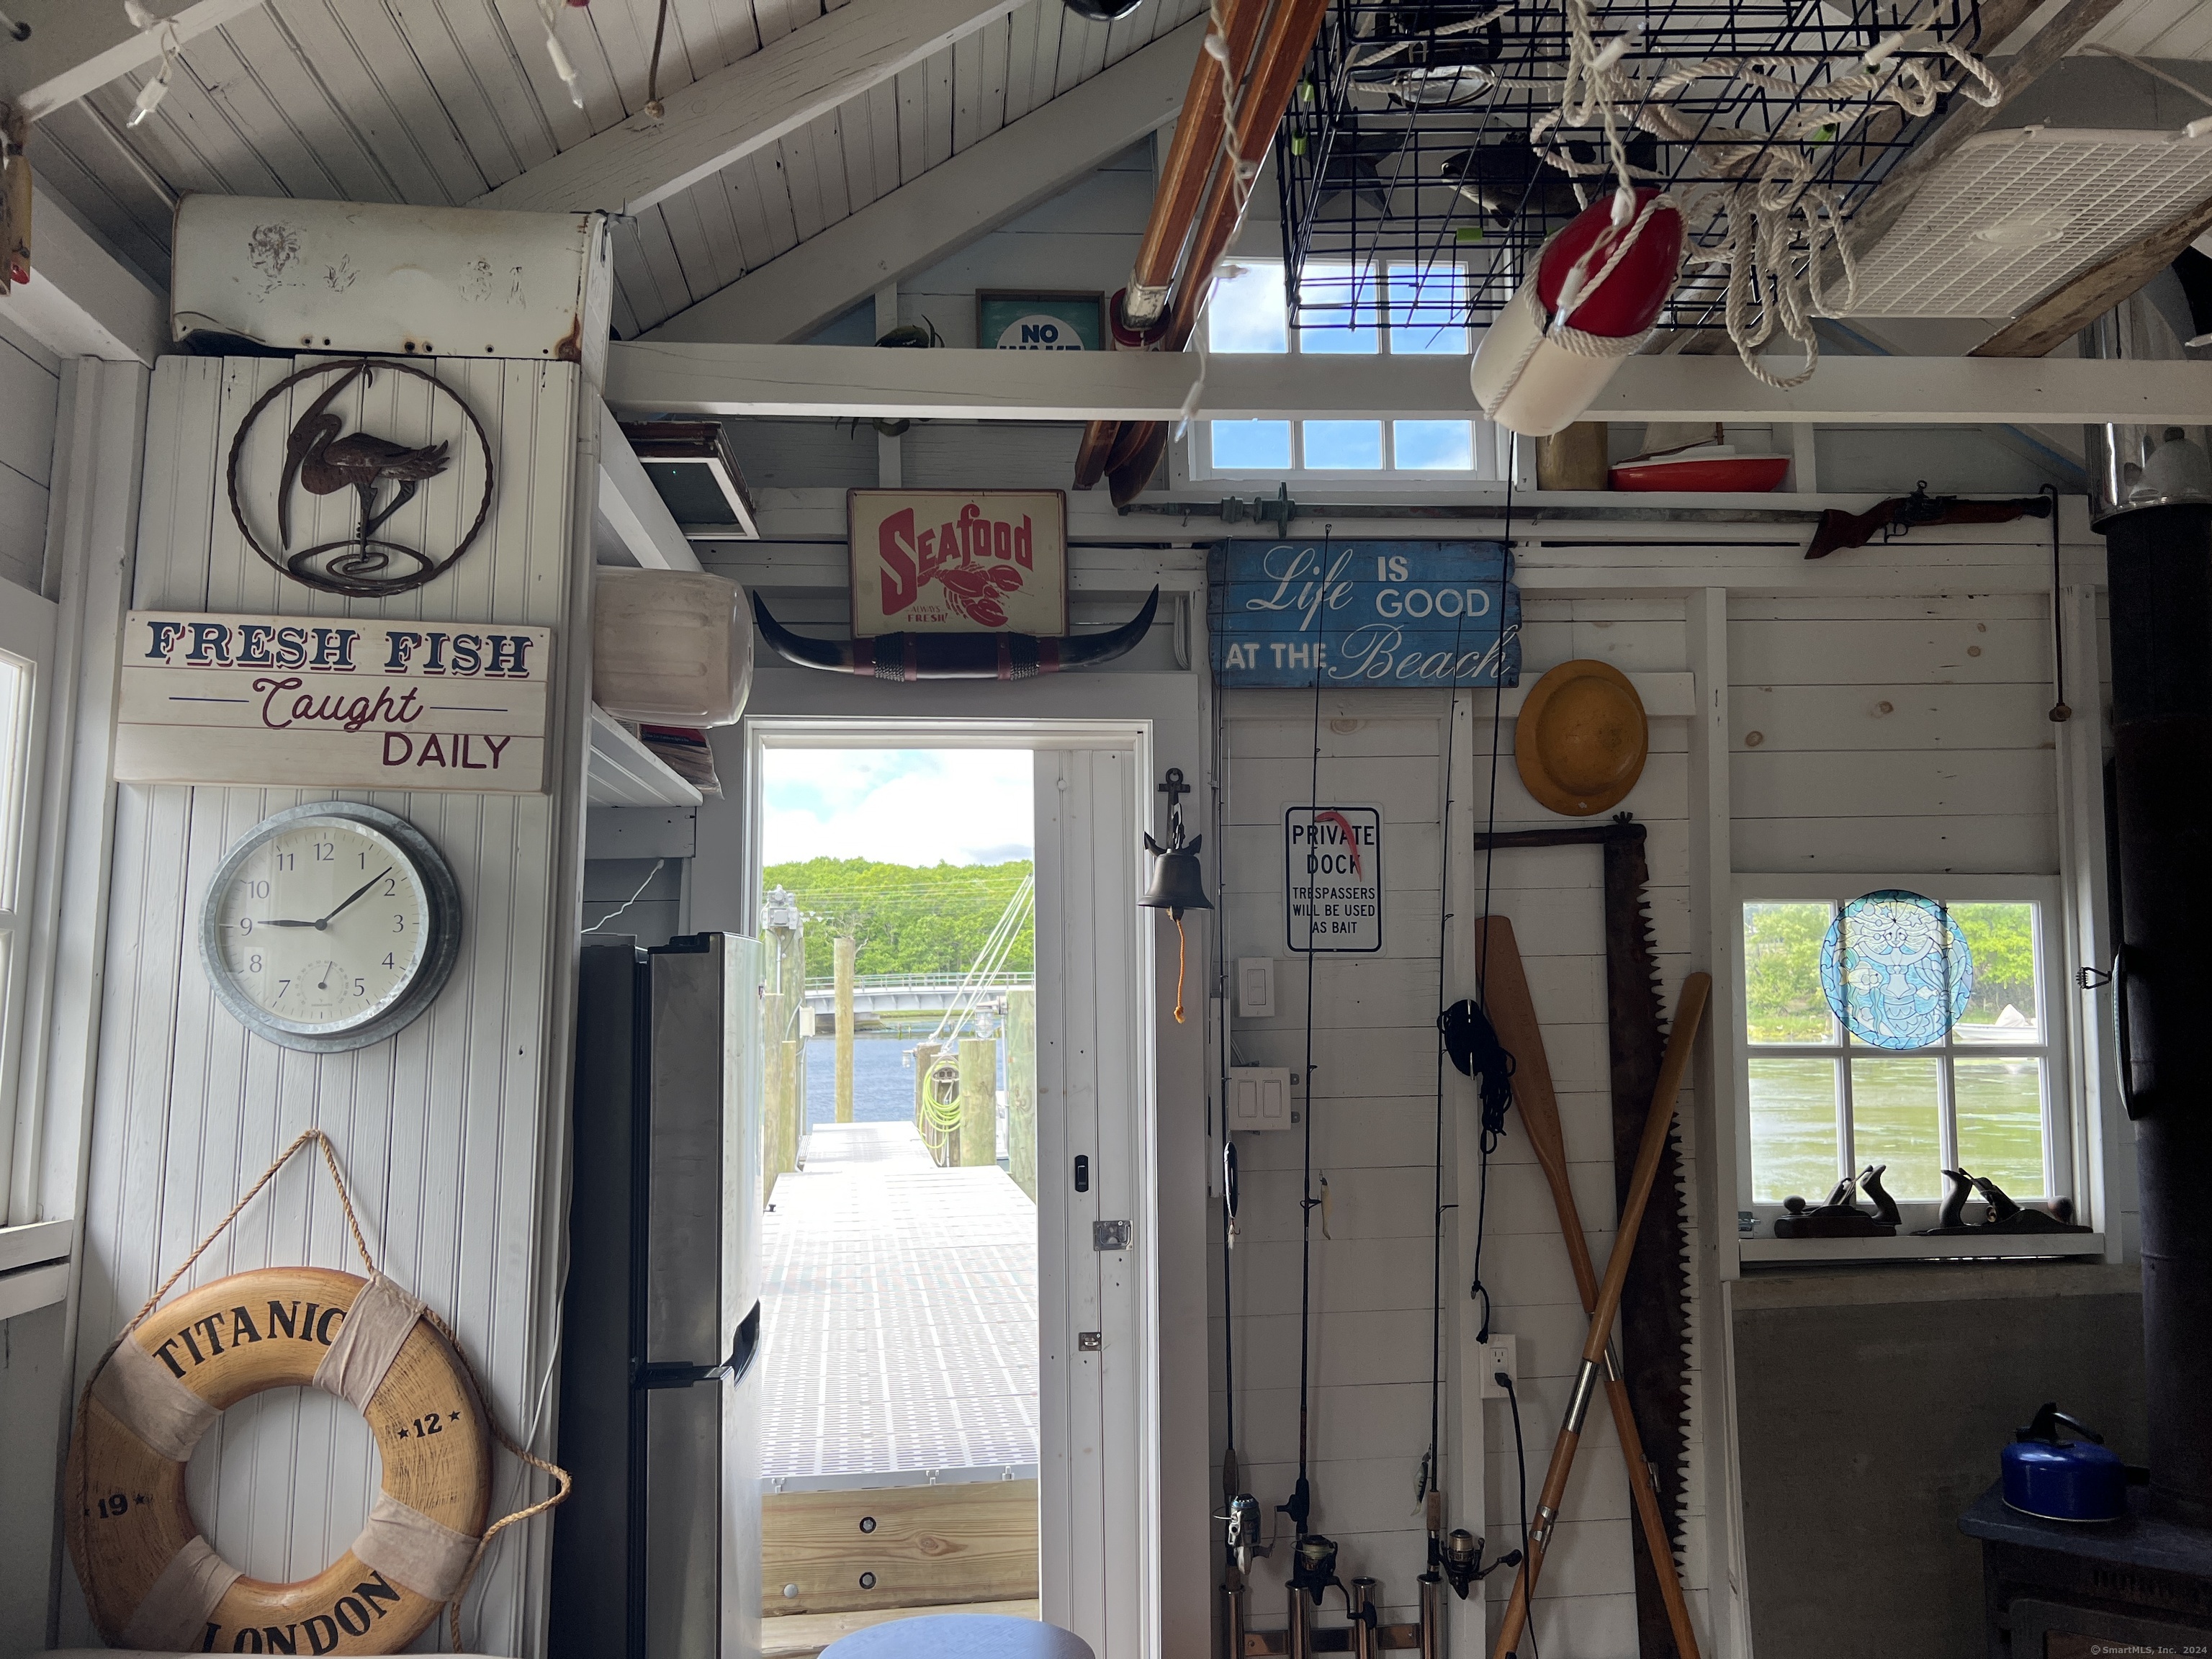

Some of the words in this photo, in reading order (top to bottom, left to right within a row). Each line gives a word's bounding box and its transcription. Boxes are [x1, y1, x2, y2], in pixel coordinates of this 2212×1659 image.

[1022, 324, 1058, 343] NO
[1246, 545, 1353, 631] Life
[1378, 556, 1408, 582] IS
[1376, 589, 1490, 618] GOOD
[145, 621, 360, 671] FRESH
[384, 631, 533, 677] FISH
[1226, 643, 1259, 670] AT
[1270, 643, 1326, 670] THE
[1328, 624, 1519, 680] Beach
[252, 678, 423, 732] Caught
[382, 732, 511, 769] DAILY
[1292, 825, 1375, 845] PRIVATE
[313, 843, 335, 861] 12
[358, 853, 365, 870] 1
[276, 853, 294, 871] 11
[248, 881, 270, 899] 10
[384, 878, 395, 896] 2
[1292, 887, 1375, 899] TRESPASSERS
[1292, 904, 1320, 917] WILL
[1325, 904, 1339, 917] BE
[1344, 904, 1375, 917] USED
[240, 918, 253, 936] 9
[392, 914, 404, 933] 3
[1311, 922, 1327, 933] AS
[1332, 922, 1357, 933] BAIT
[249, 955, 262, 973] 8
[382, 952, 395, 970] 4
[279, 979, 290, 998] 7
[353, 979, 365, 997] 5
[153, 1300, 349, 1378] TITANIC
[413, 1413, 442, 1439] 12
[98, 1493, 128, 1519] 19
[200, 1570, 400, 1655] LONDON
